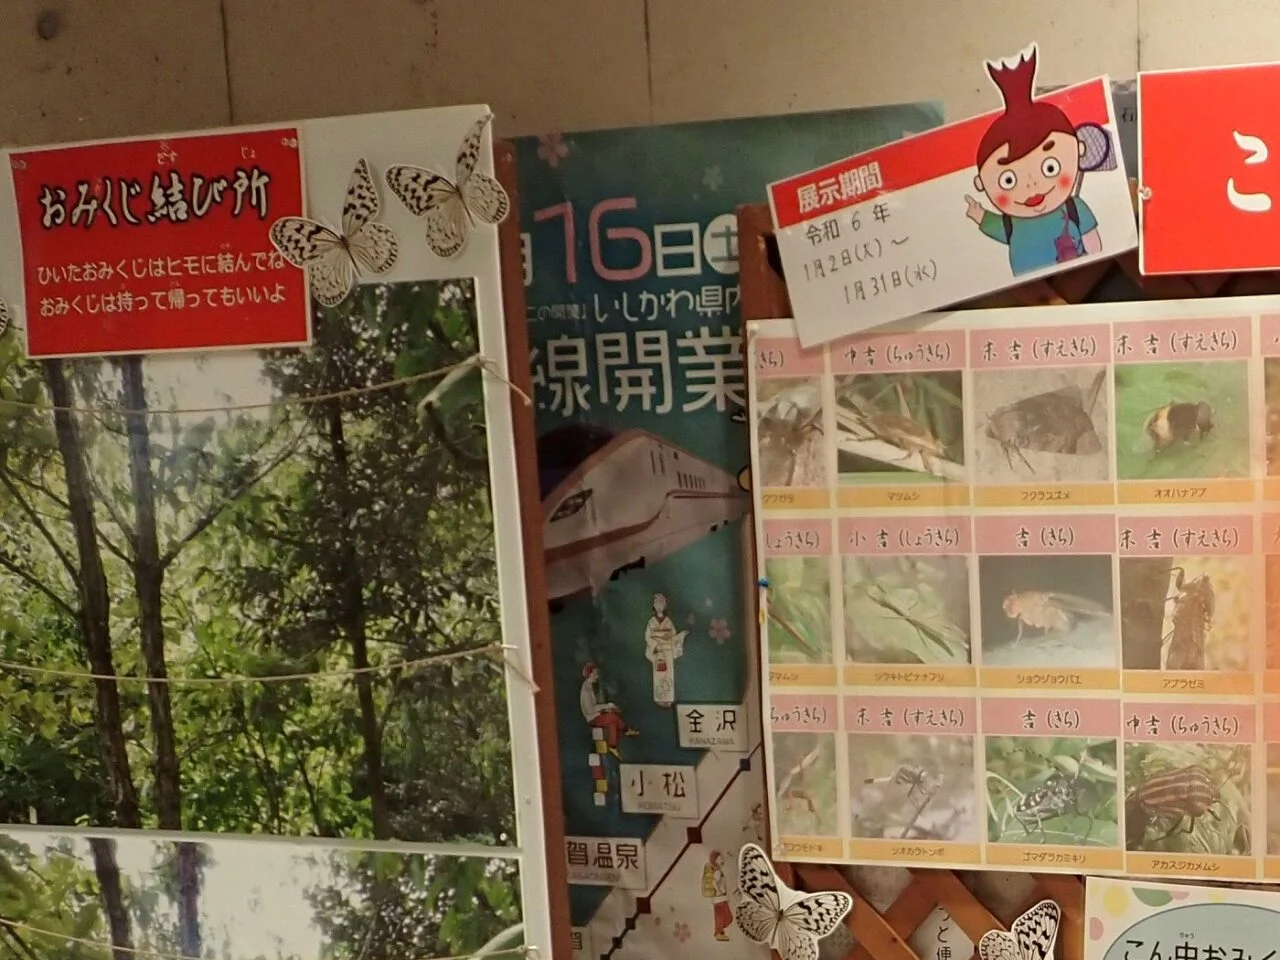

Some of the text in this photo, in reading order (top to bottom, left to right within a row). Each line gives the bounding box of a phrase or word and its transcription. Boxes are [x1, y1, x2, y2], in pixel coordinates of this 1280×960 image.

[39, 167, 271, 229] おみくじ結び所
[797, 161, 883, 214] 展示期間
[39, 281, 286, 317] おみくじは持って帰ってもいいよ
[630, 770, 686, 799] 小松
